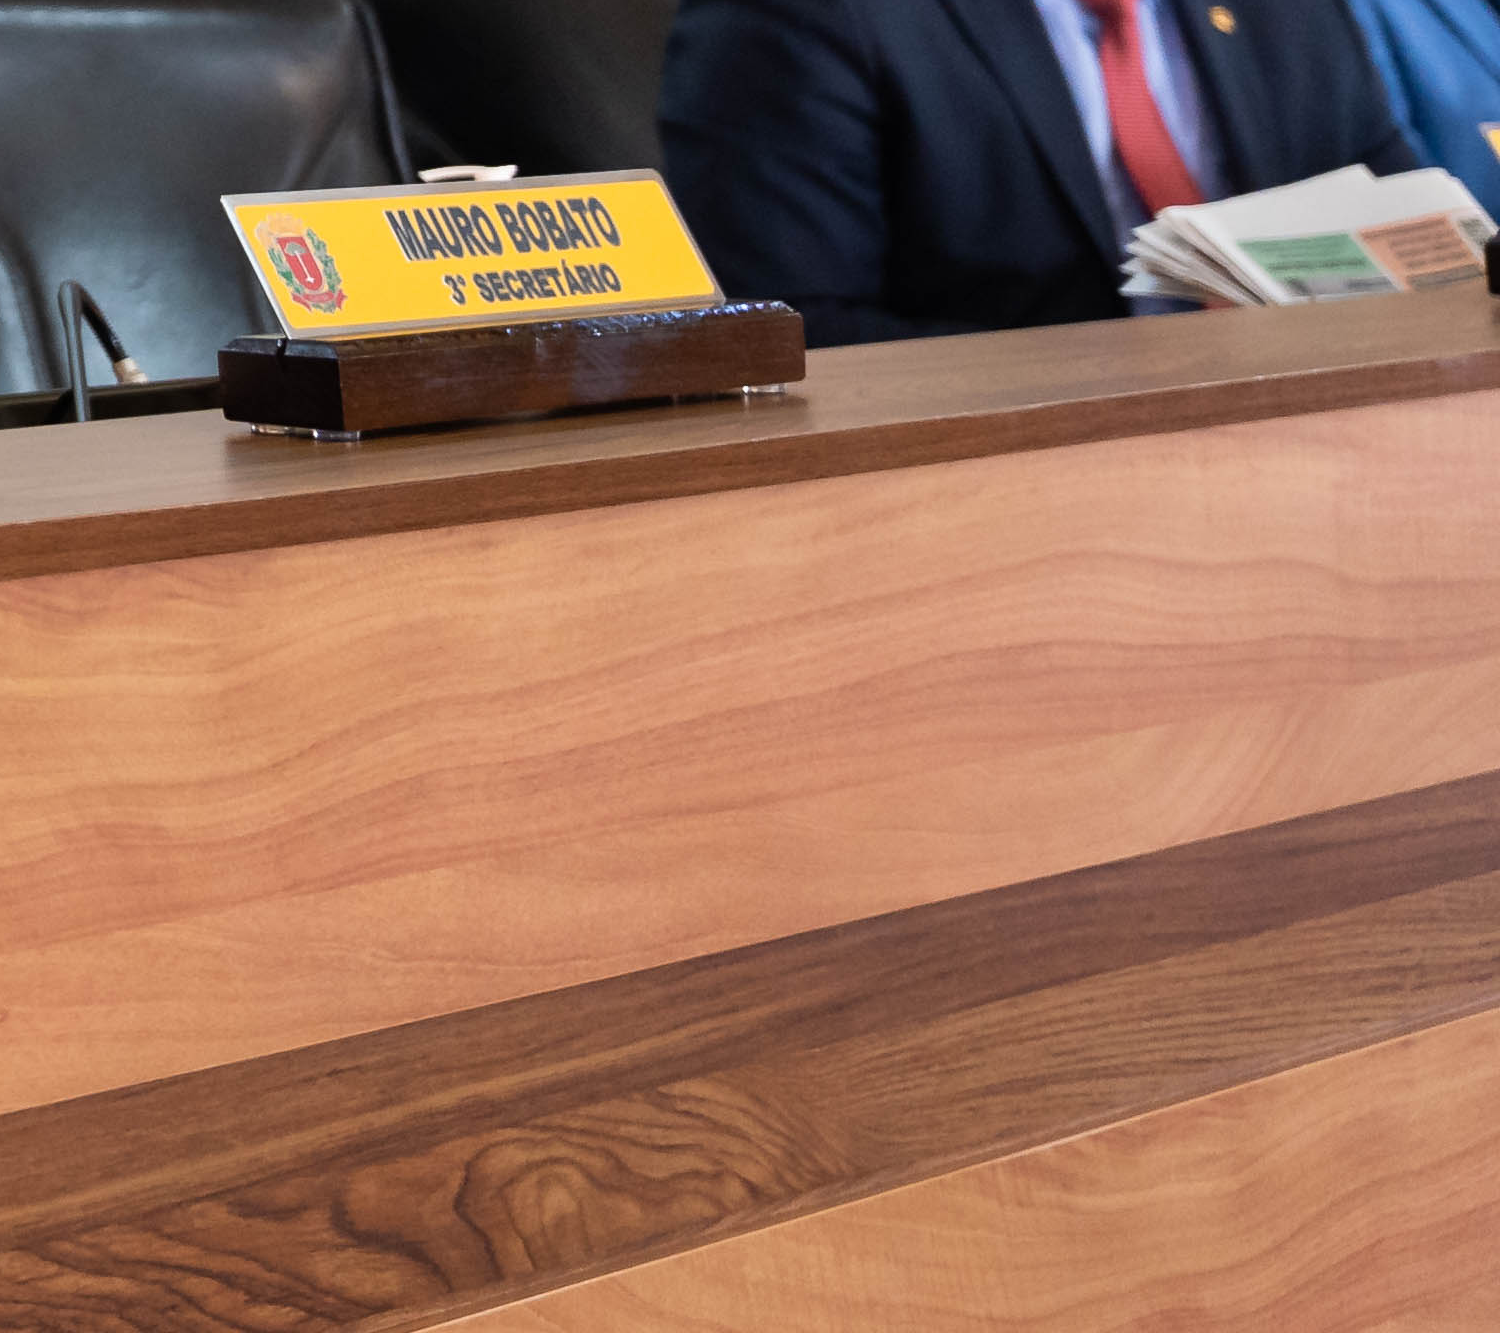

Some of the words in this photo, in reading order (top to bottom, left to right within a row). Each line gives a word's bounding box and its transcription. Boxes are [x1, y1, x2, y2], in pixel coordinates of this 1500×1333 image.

[384, 205, 503, 262] MAURO
[495, 197, 621, 253] BOBATO
[473, 259, 622, 302] SECRETÁRIO
